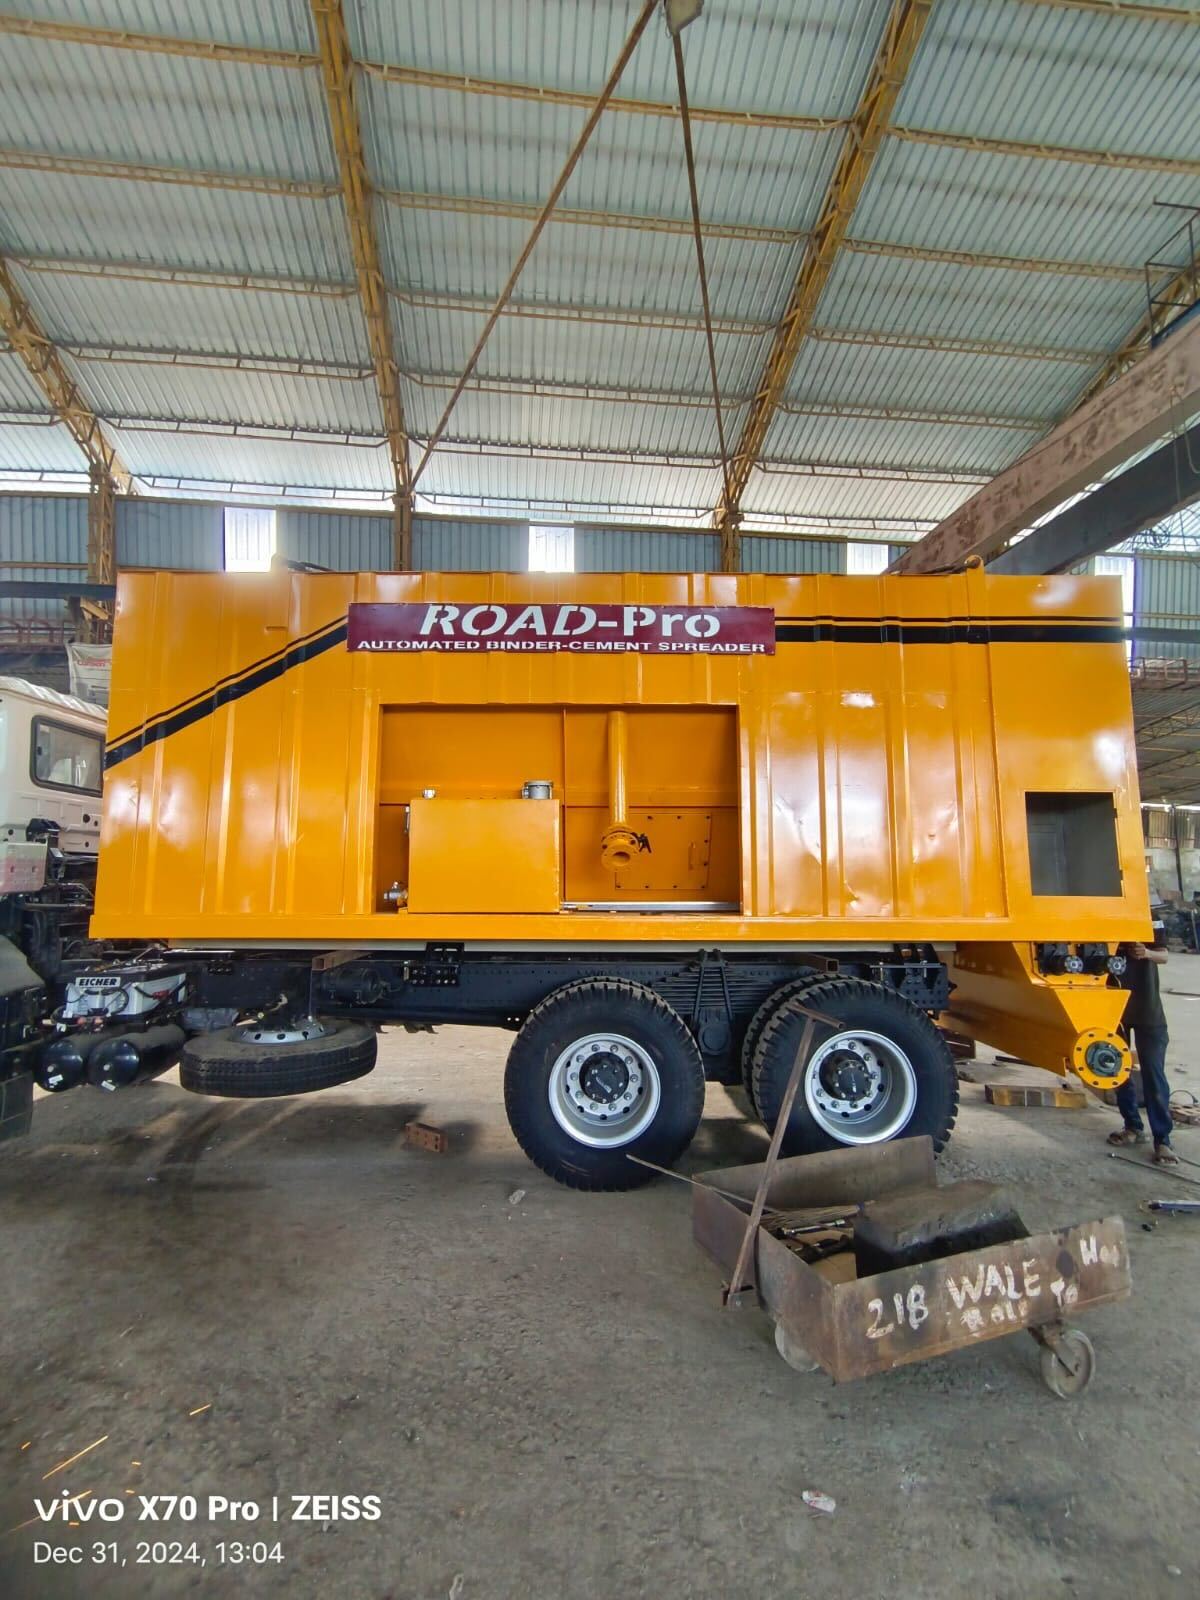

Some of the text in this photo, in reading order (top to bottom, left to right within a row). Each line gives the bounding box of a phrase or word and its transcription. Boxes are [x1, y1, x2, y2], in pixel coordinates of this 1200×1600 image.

[420, 604, 721, 638] ROAD-Pro
[357, 640, 765, 652] AUTOMATED BINDER-CEMENT SPREADER
[79, 978, 117, 986] EICHER
[945, 1258, 1041, 1309] WALE
